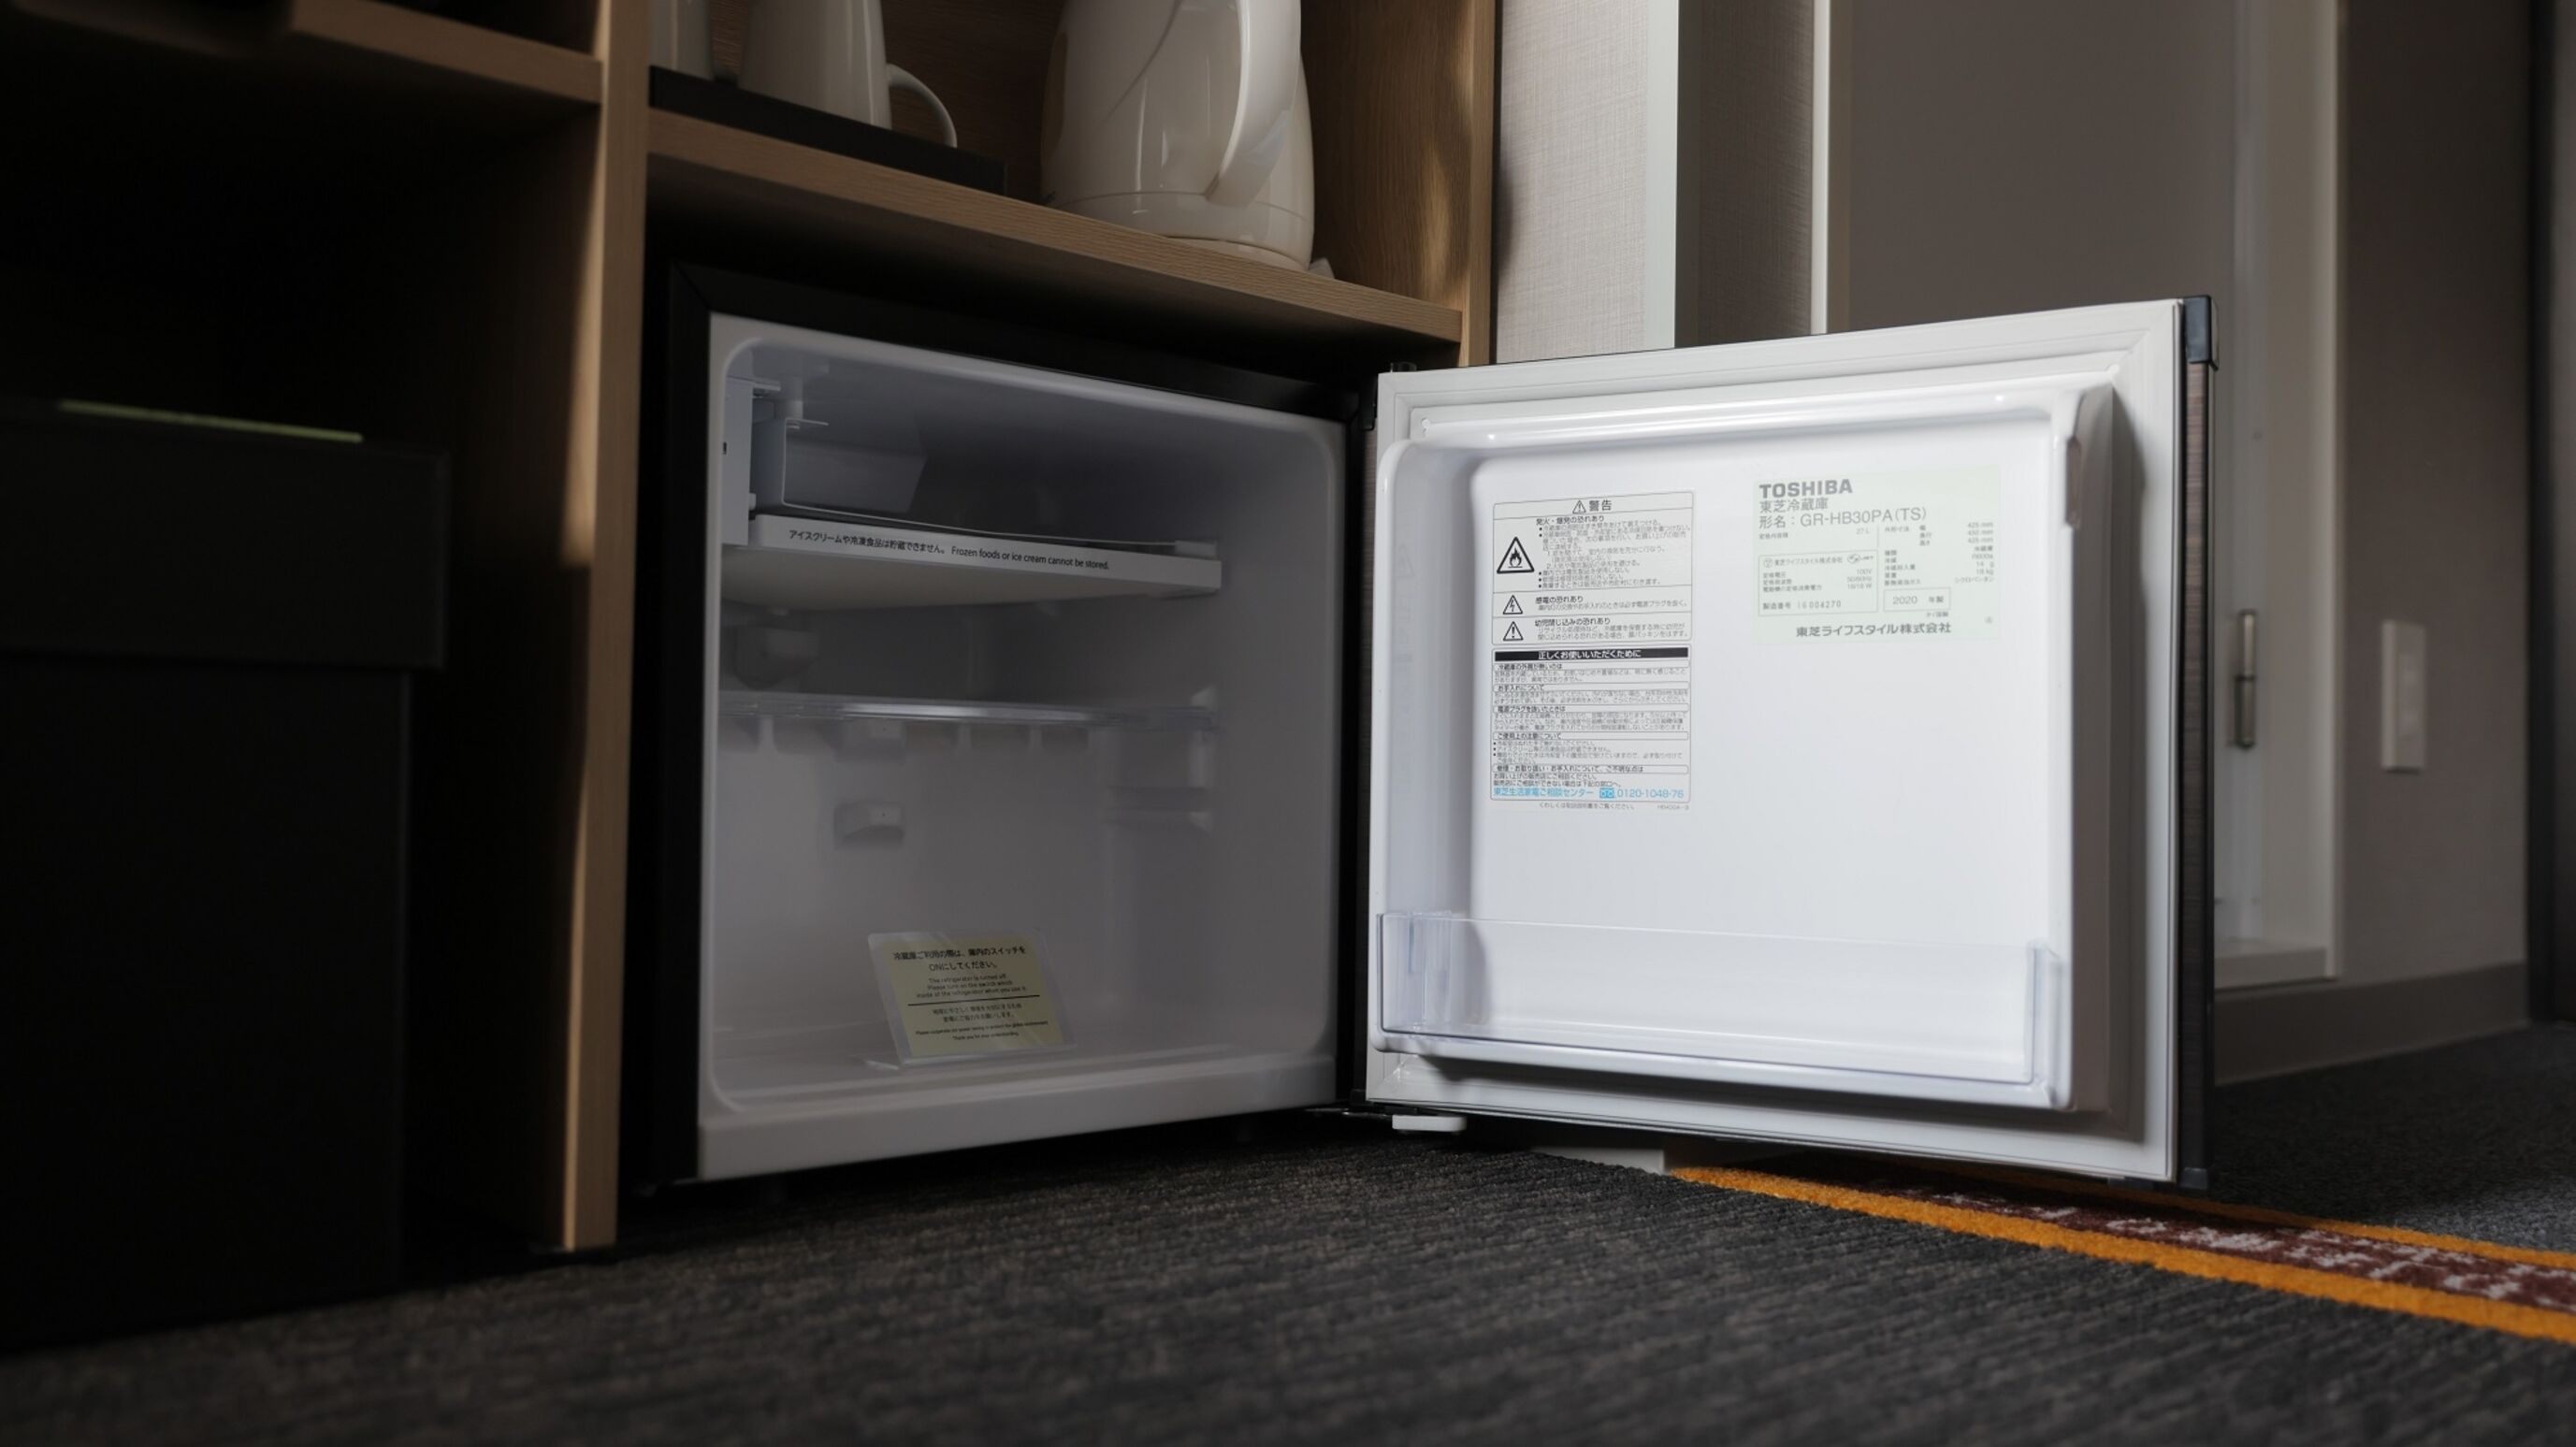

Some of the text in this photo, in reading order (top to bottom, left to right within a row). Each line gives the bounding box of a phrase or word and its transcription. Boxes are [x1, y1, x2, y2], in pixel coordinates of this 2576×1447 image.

[1759, 478, 1853, 499] TOSHIBA
[1589, 499, 1613, 512] 警告
[1759, 498, 1829, 514] 東芝冷蔵庫
[1536, 515, 1604, 526] 発火・爆発の恐れあり
[789, 529, 945, 554] アイスクリームや冷凍食品は貯蔵できません。
[951, 545, 977, 557] Frozen
[978, 548, 1001, 559] foods
[1011, 552, 1022, 561] ice
[1023, 555, 1046, 563] cream
[1048, 557, 1073, 566] cannot
[1075, 557, 1084, 567] be
[1085, 560, 1109, 570] stored.
[1535, 596, 1584, 604] 感電の恐れあり
[1892, 596, 1918, 604] 2020
[1796, 622, 1951, 638] 東芝ライフスタイル株式会社
[1538, 649, 1642, 660] 正しくお使いいただくために
[1616, 789, 1685, 799] 0120-1048-76
